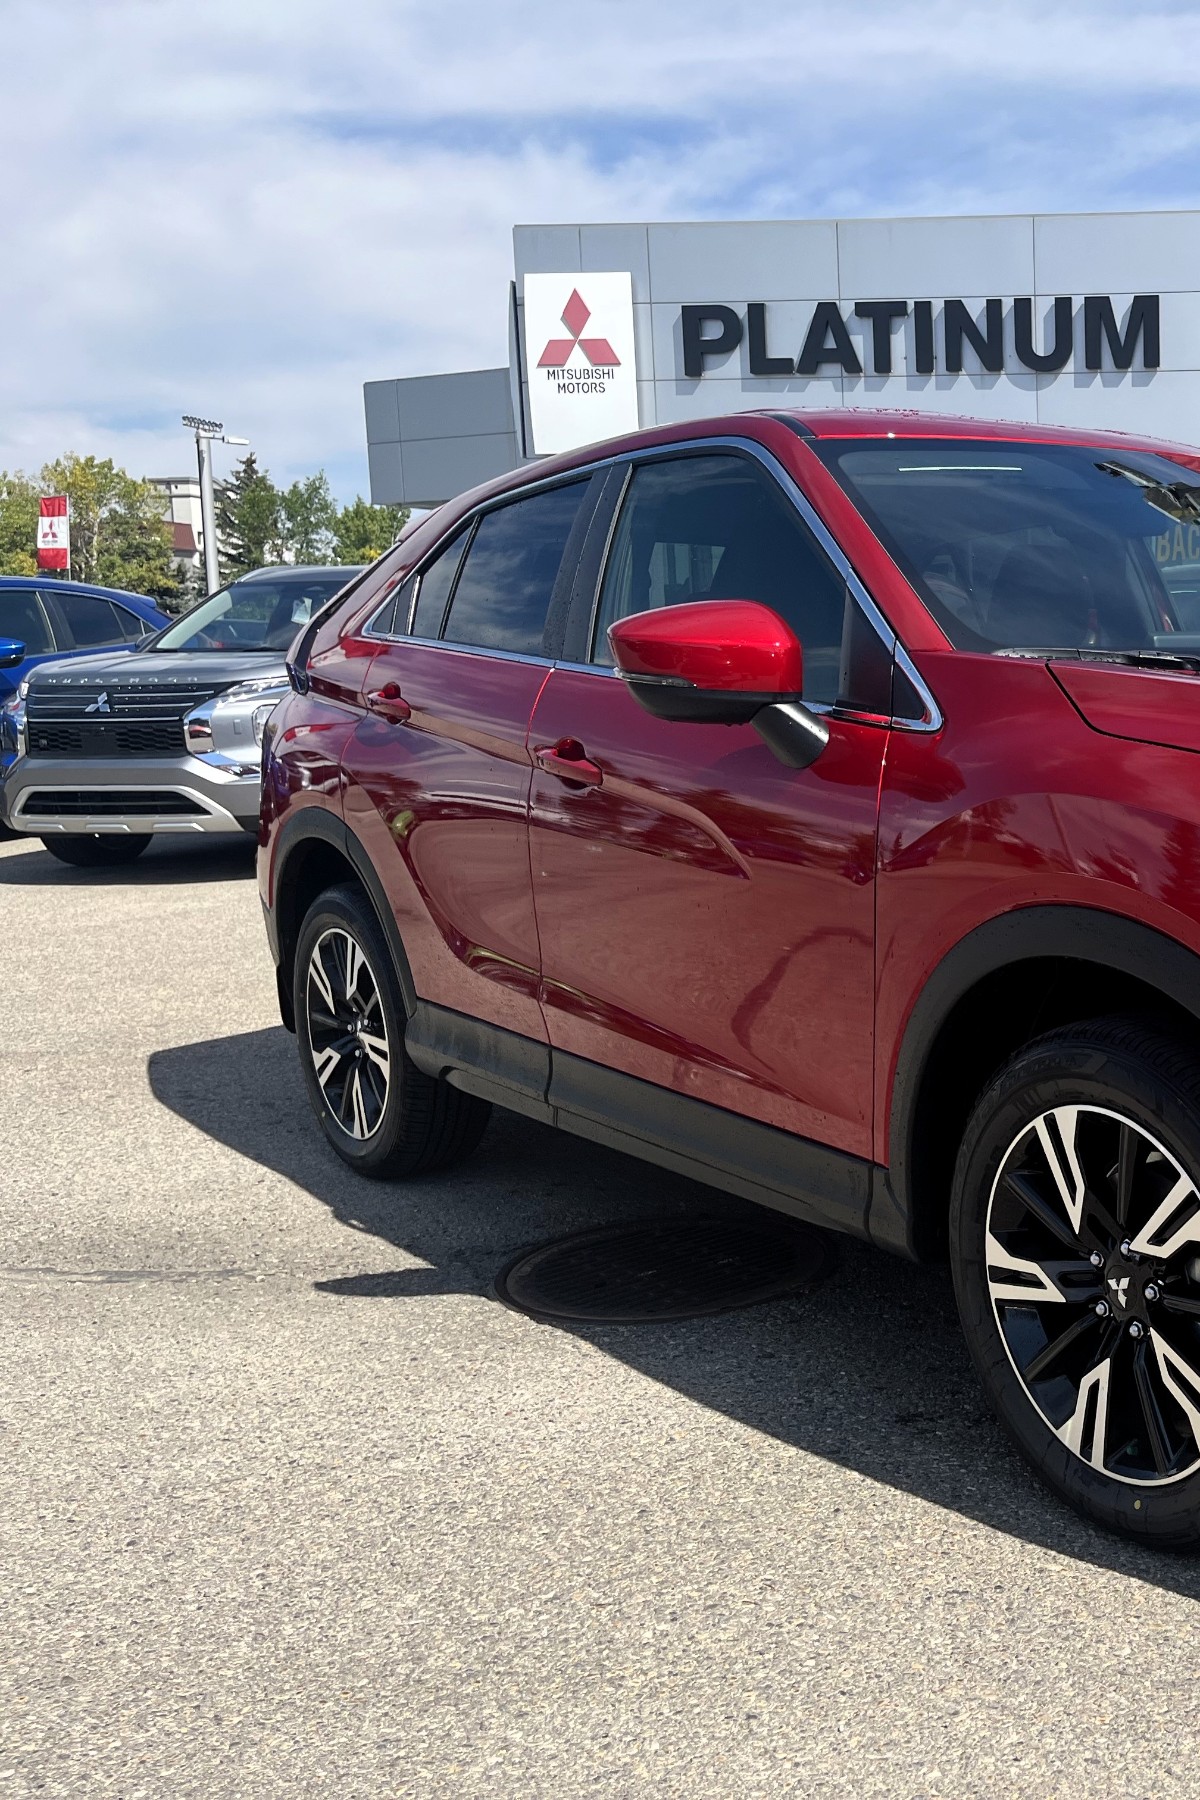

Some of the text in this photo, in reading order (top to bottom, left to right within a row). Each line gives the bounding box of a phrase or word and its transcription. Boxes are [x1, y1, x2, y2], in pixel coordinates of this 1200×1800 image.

[681, 295, 1160, 377] PLATINUM
[547, 368, 614, 380] MITSUBISHI
[557, 382, 606, 394] MOTORS
